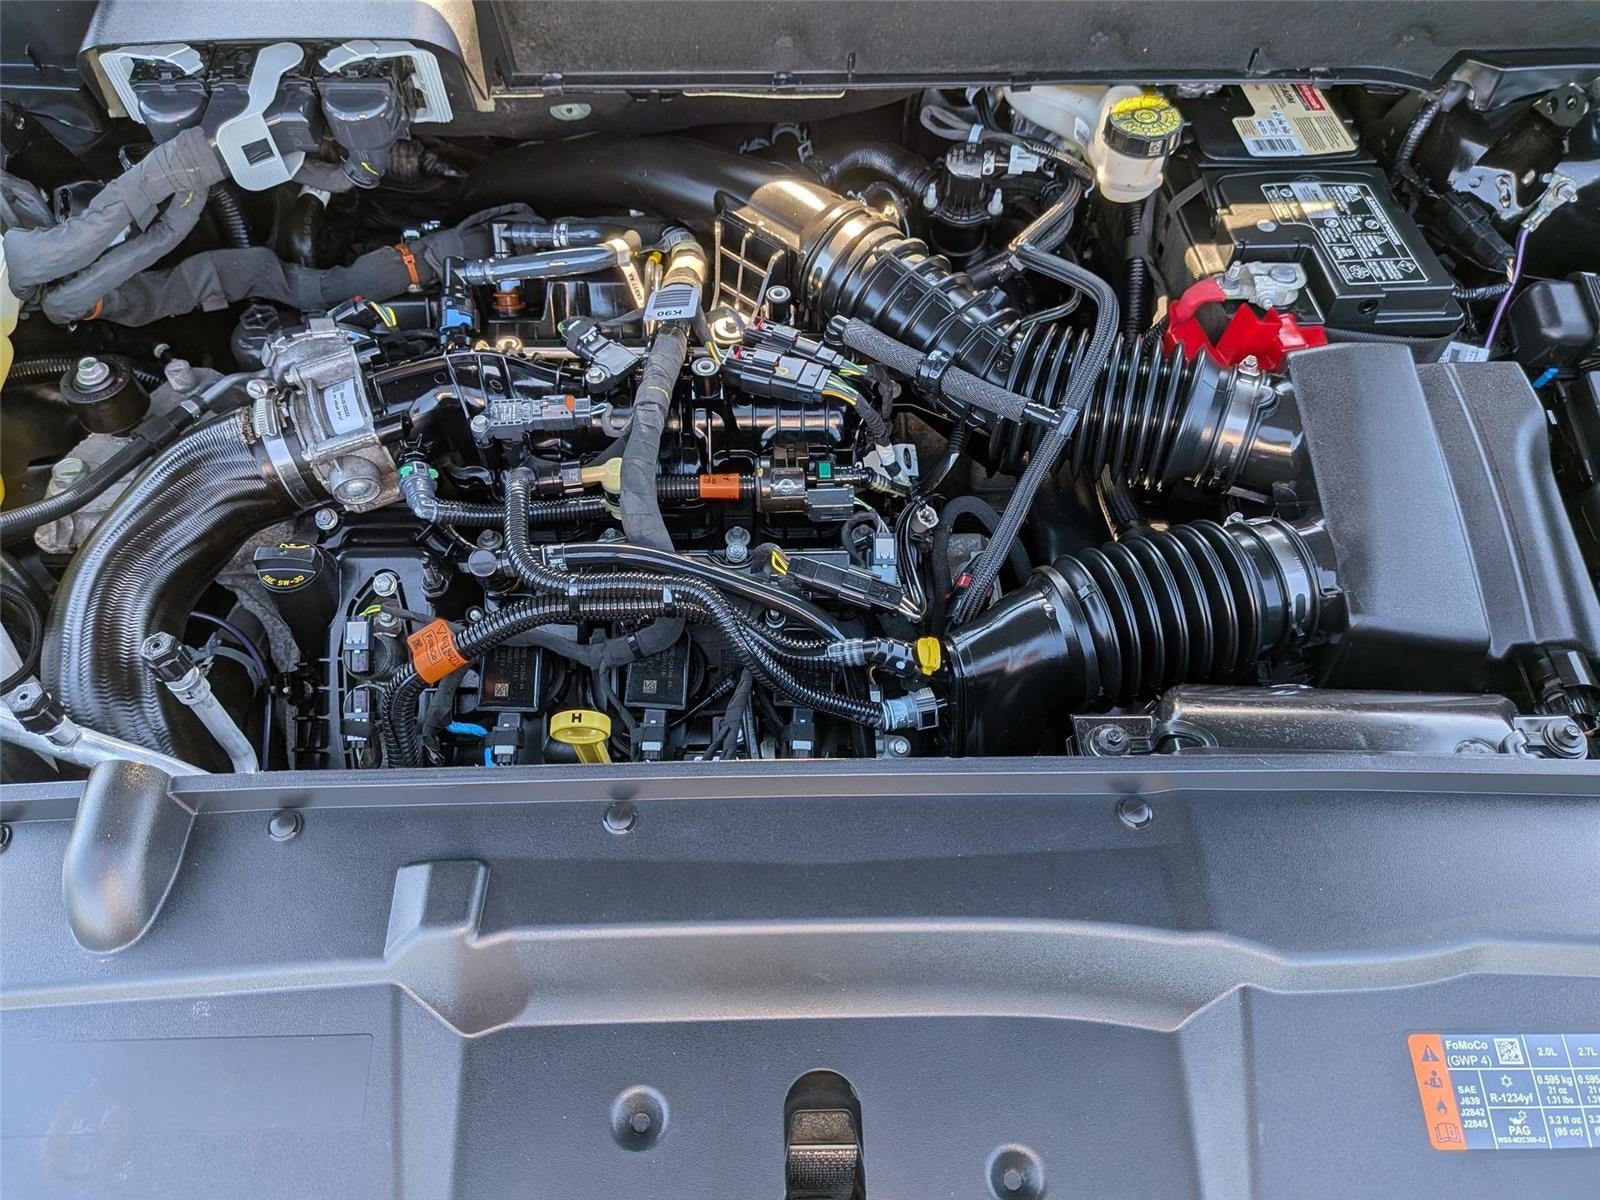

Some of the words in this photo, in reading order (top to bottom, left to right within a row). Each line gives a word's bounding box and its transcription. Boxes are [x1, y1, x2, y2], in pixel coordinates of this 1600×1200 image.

[657, 309, 682, 317] K90
[262, 574, 276, 585] SAE
[277, 575, 305, 587] 5W-30
[571, 712, 583, 723] H
[1445, 1040, 1488, 1050] FoMoCo
[1536, 1047, 1558, 1056] 2.0L
[1577, 1046, 1598, 1056] 2.7L
[1447, 1055, 1478, 1067] (GWP
[1480, 1055, 1492, 1067] 4)
[1536, 1075, 1560, 1085] 0.595
[1561, 1074, 1574, 1087] kg
[1457, 1085, 1477, 1094] SAE
[1460, 1097, 1480, 1105] J639
[1490, 1093, 1533, 1105] R-1234yf
[1562, 1095, 1574, 1104] lbs
[1508, 1126, 1531, 1136] PAG
[1569, 1127, 1583, 1137] cc)
